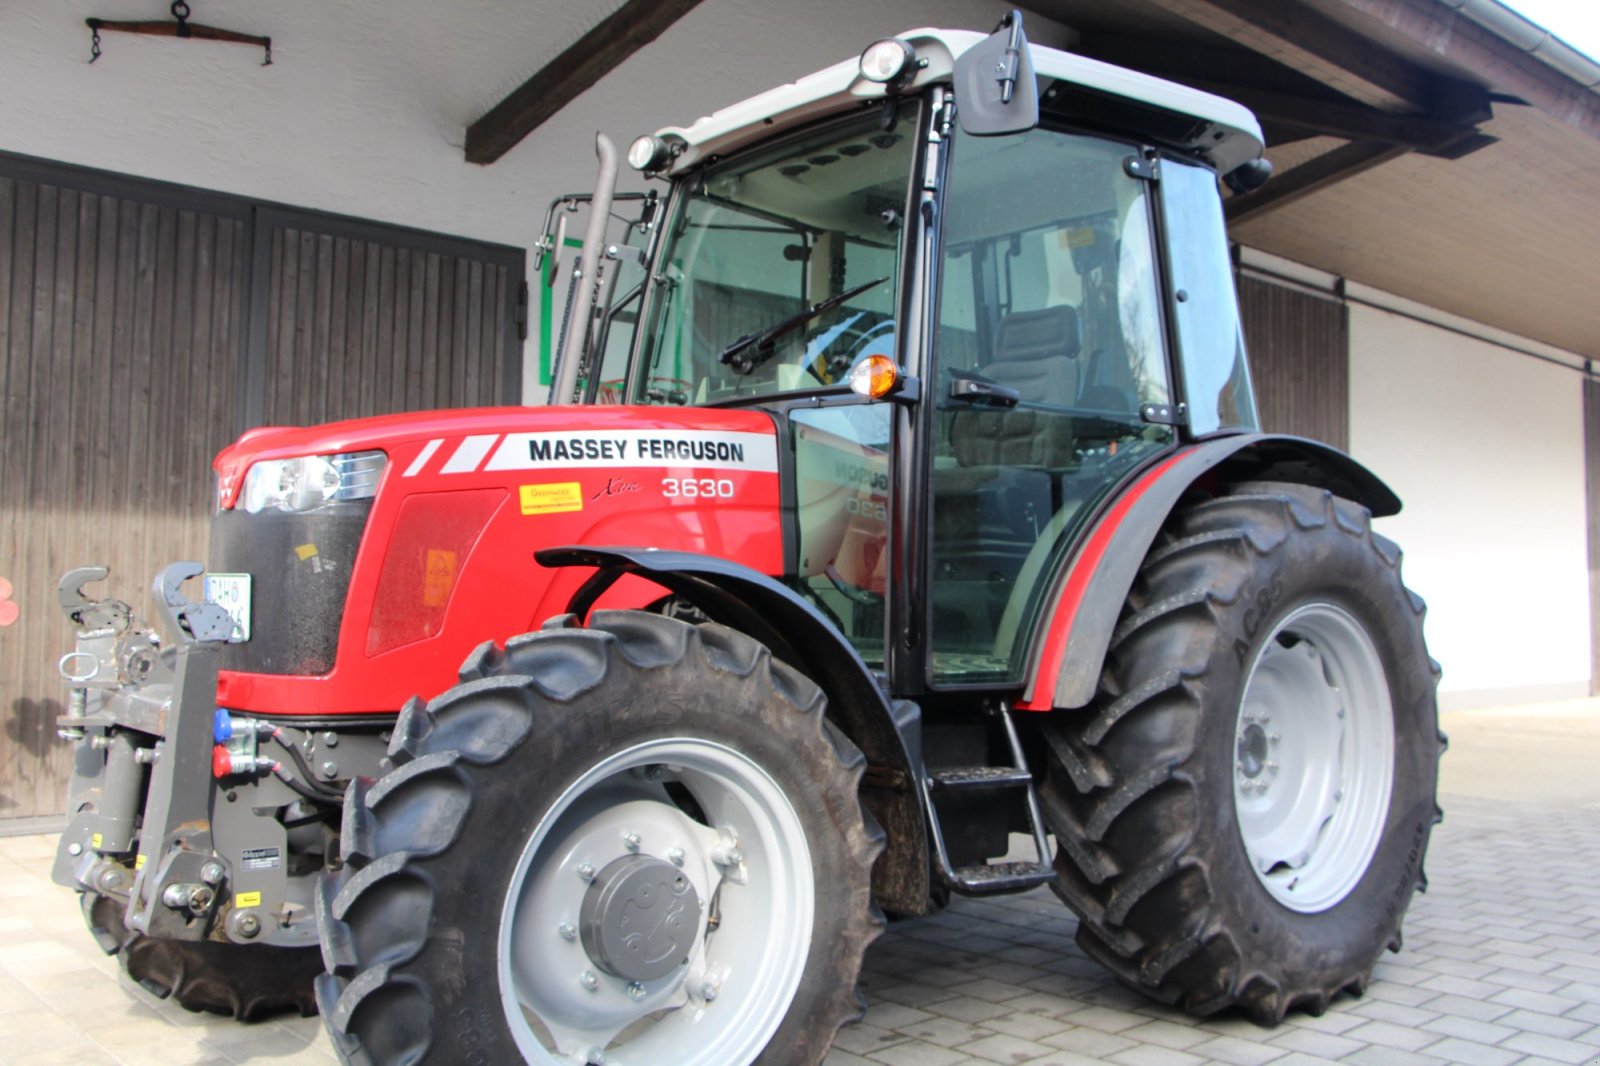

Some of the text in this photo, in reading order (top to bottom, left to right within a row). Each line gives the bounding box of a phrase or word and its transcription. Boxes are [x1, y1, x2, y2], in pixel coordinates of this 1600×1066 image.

[529, 438, 744, 462] MASSEY FERGUSON
[661, 477, 735, 497] 3630
